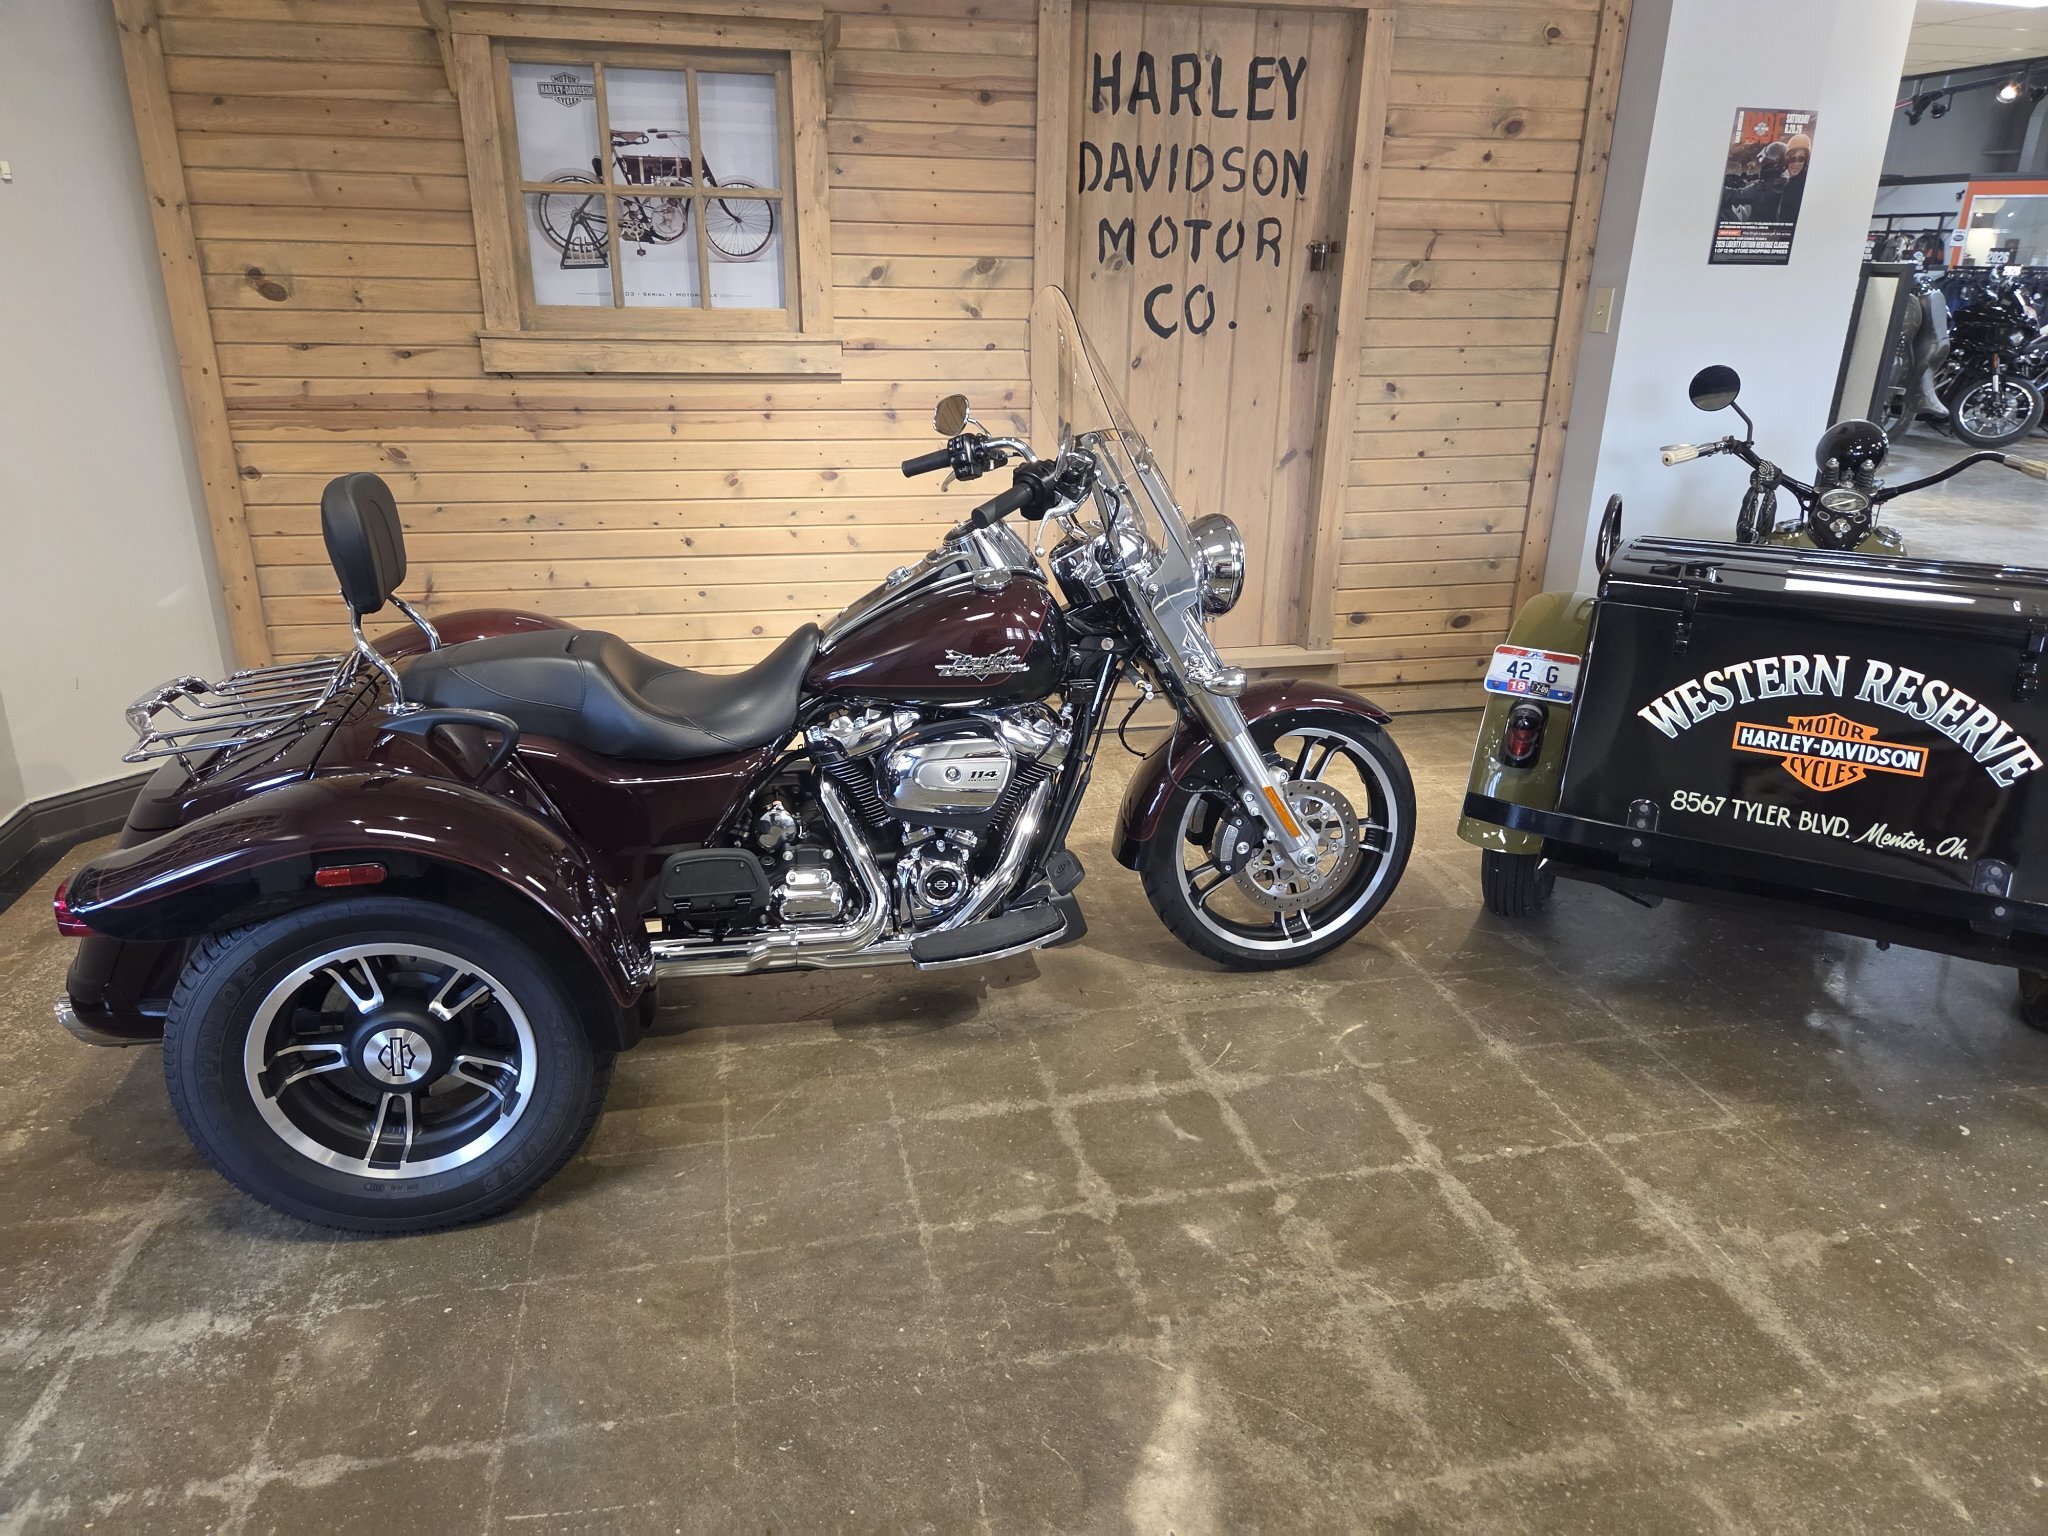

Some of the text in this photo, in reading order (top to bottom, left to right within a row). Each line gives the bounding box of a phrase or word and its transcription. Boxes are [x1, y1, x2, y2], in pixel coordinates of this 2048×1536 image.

[540, 84, 593, 95] HARLEY-DAVIDSON
[1092, 51, 1307, 120] HARLEY
[1785, 113, 1810, 123] SATURDAY
[1079, 141, 1308, 198] DAVIDSON
[1099, 215, 1282, 267] MOTOR
[1144, 284, 1238, 339] CO.
[1506, 660, 1559, 683] 42 G
[1509, 680, 1526, 690] 18
[1637, 654, 2044, 789] WESTERN RESERVE
[1797, 716, 1864, 740] MOTOR
[1740, 728, 1920, 770] HARLEY-DAVIDSON
[970, 770, 999, 778] 114
[1790, 756, 1860, 790] CYCLES
[1670, 790, 1969, 861] 8567 TYLER BLVD. Mentor, Oh.
